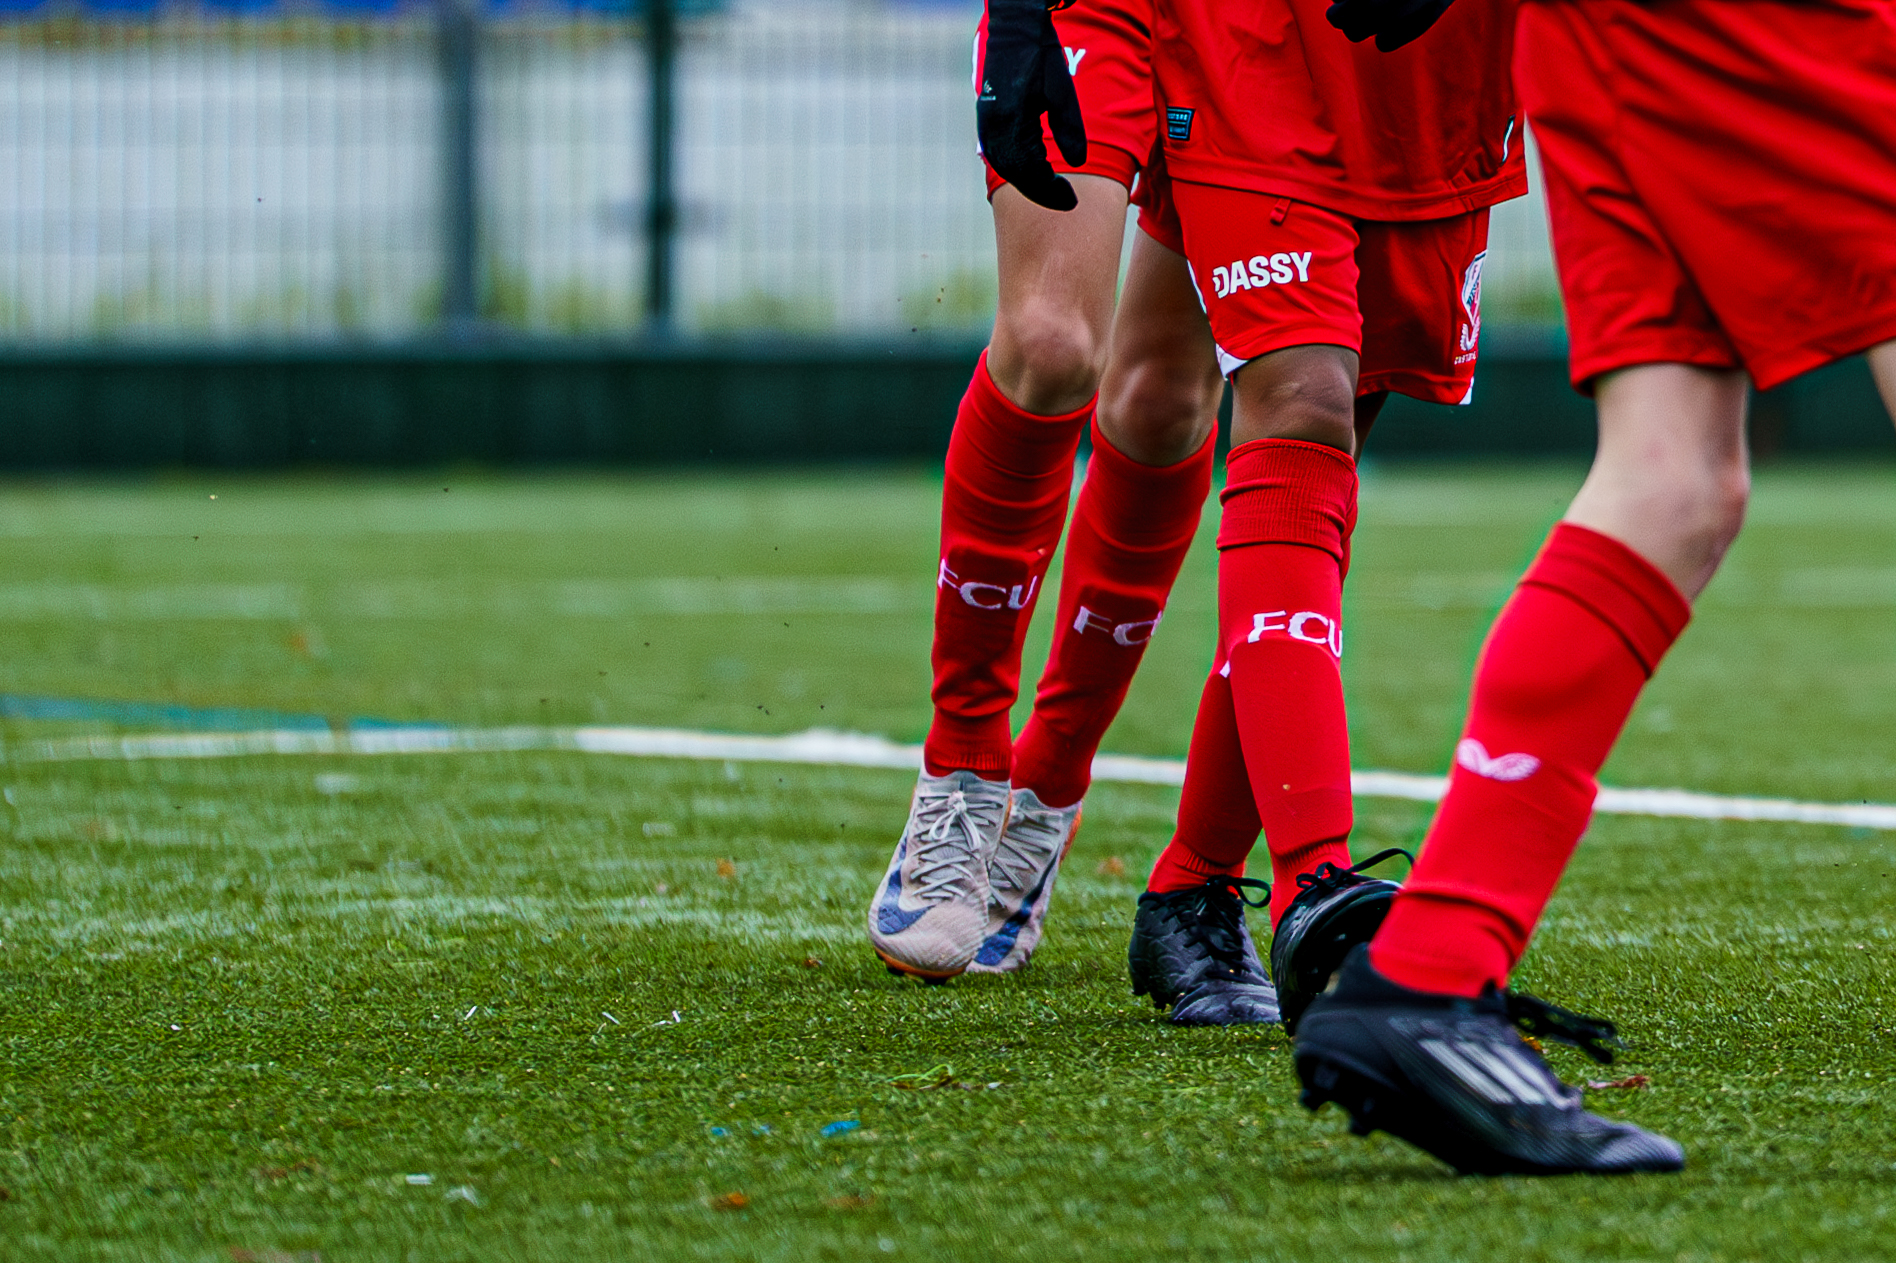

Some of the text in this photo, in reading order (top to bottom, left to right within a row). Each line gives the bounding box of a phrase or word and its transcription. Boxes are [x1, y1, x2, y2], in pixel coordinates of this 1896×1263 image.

[1212, 251, 1312, 299] DASSY
[937, 558, 1038, 610] FCU
[1072, 605, 1163, 646] FC
[1247, 609, 1343, 658] FCU
